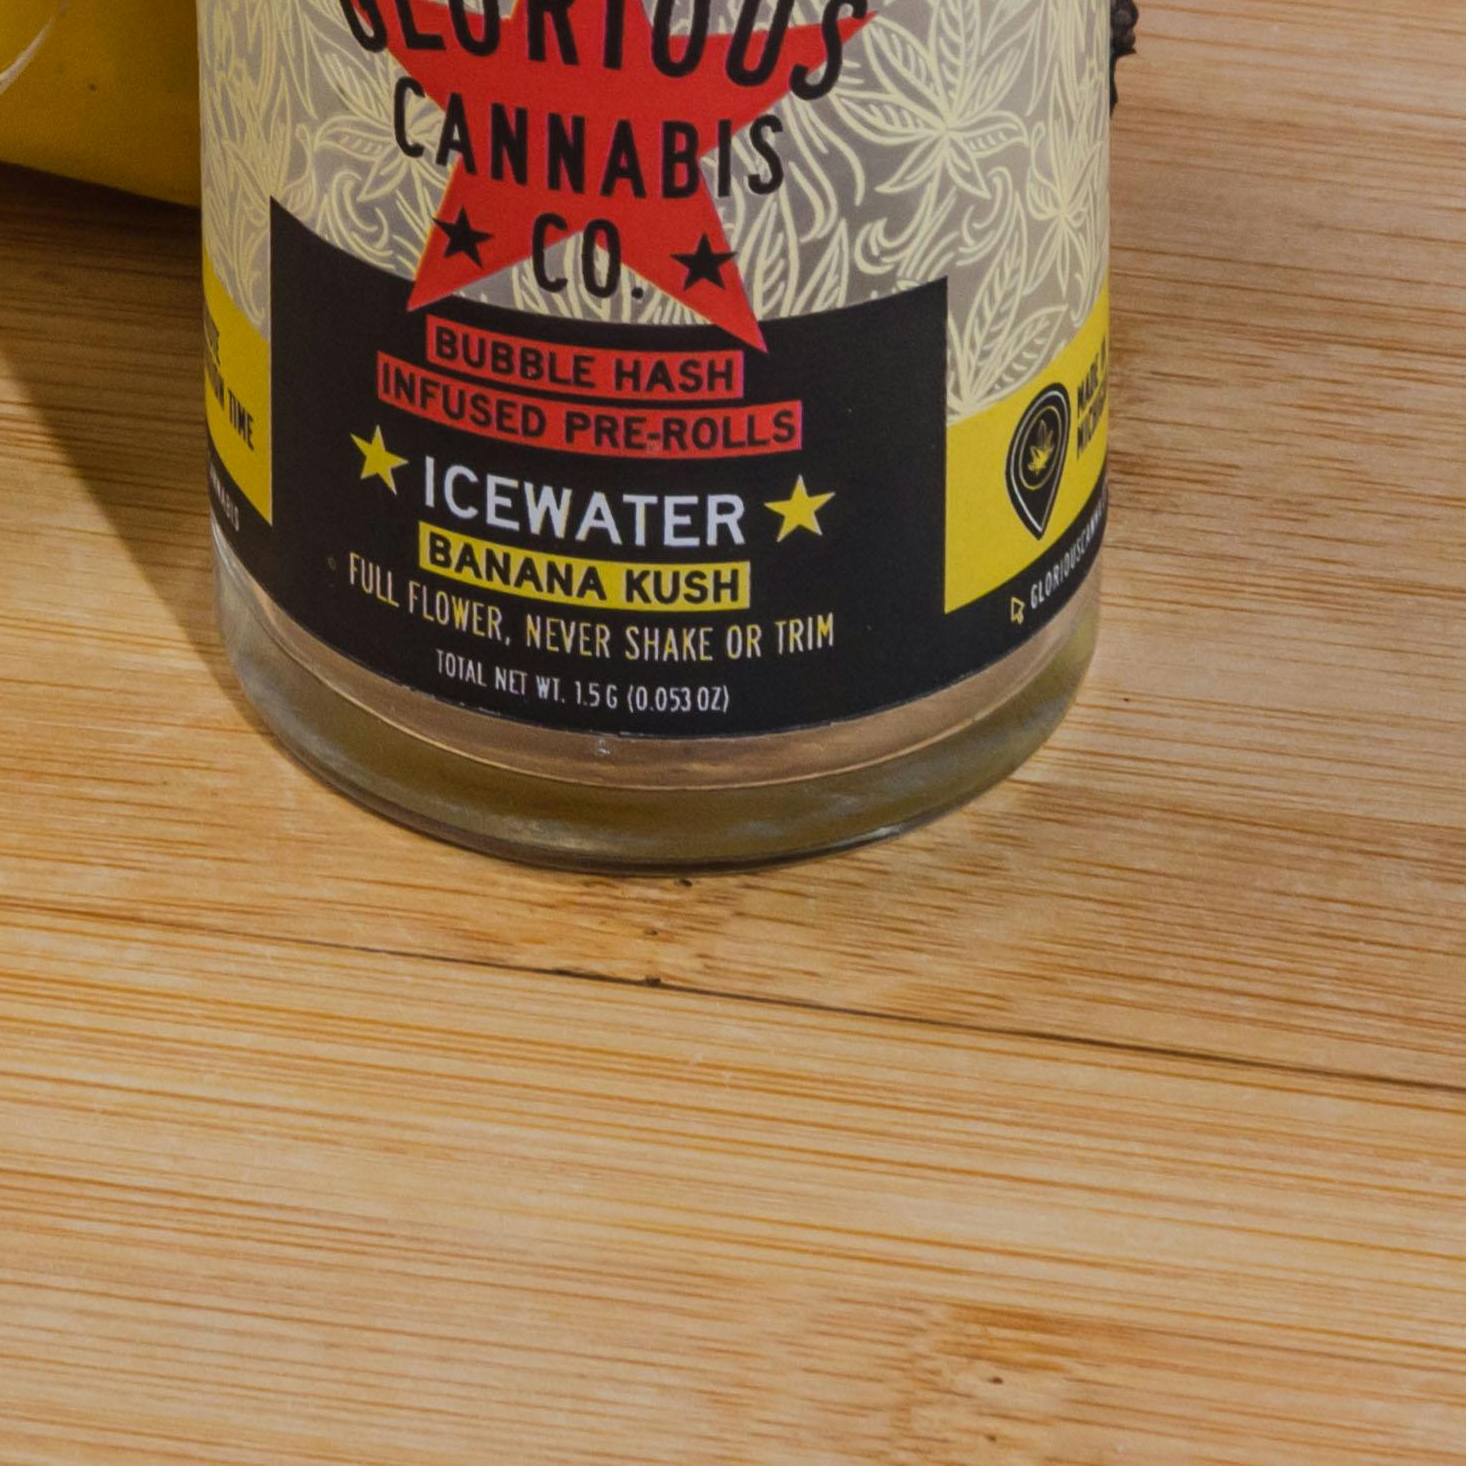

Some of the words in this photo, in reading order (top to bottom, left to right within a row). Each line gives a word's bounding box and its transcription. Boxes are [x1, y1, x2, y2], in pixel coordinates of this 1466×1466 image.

[393, 76, 784, 199] CANNABIS
[531, 213, 645, 300] CO.
[435, 325, 596, 388] BUBBLE
[614, 358, 734, 398] HASH
[227, 389, 255, 452] TIME
[382, 360, 547, 438] INFUSED
[564, 410, 796, 451] PRE-ROLLS
[424, 456, 746, 547] ICEWATER
[349, 552, 400, 608] FULL
[408, 582, 511, 647] FLOWER,
[526, 614, 611, 659] NEVER
[625, 626, 714, 663] SHAKE
[725, 624, 763, 660] OR
[775, 613, 835, 655] TRIM
[428, 531, 607, 602] BANANA
[624, 569, 740, 604] KUSH
[436, 649, 486, 688] TOTAL
[494, 667, 529, 696] NET
[535, 675, 566, 704] WT.
